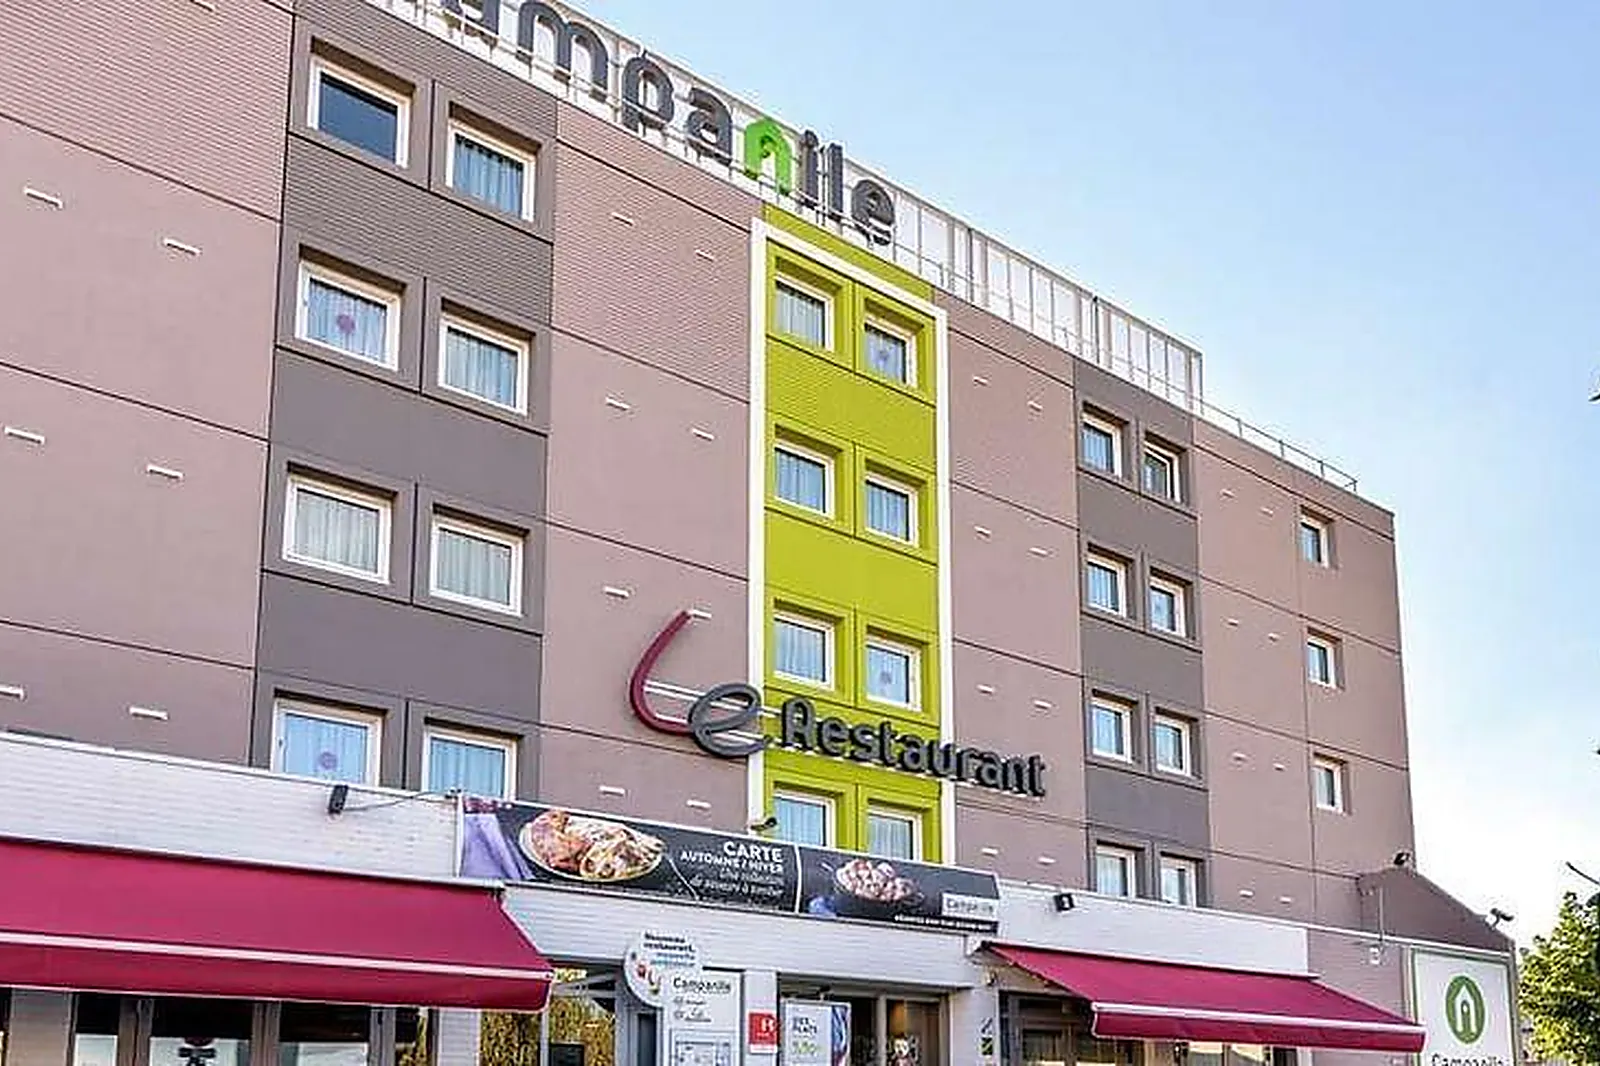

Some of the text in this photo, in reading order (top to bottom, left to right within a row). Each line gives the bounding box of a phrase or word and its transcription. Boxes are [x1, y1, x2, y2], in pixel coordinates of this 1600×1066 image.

[629, 610, 1047, 797] Le Restaurant
[723, 841, 784, 863] CARTE
